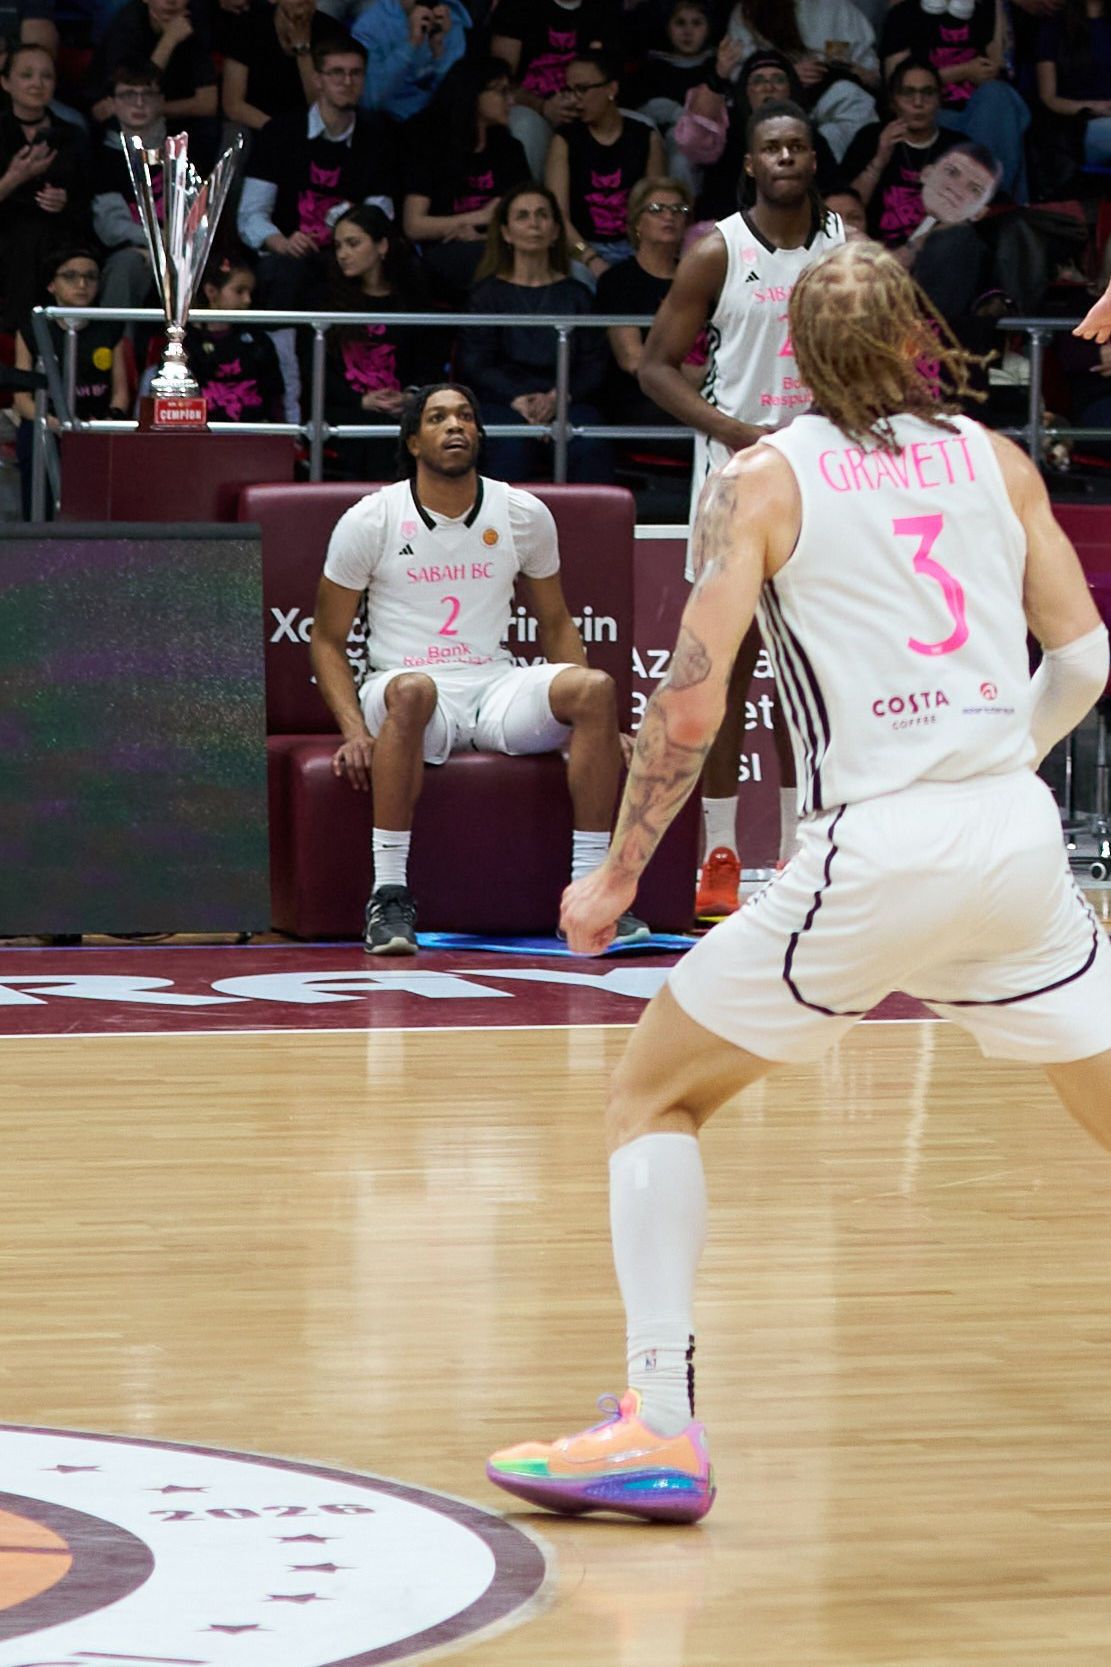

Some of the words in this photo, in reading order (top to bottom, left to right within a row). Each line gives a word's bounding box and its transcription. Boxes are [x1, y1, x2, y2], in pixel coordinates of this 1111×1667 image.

[761, 392, 815, 407] Respu
[819, 437, 976, 492] GRAVETT
[406, 564, 466, 584] SABAH
[472, 562, 495, 580] BC
[892, 514, 969, 657] 3
[438, 596, 461, 636] 2
[428, 643, 471, 659] Bank
[872, 691, 949, 717] COSTA
[892, 715, 937, 731] COFFEE
[148, 1502, 377, 1522] 2026
